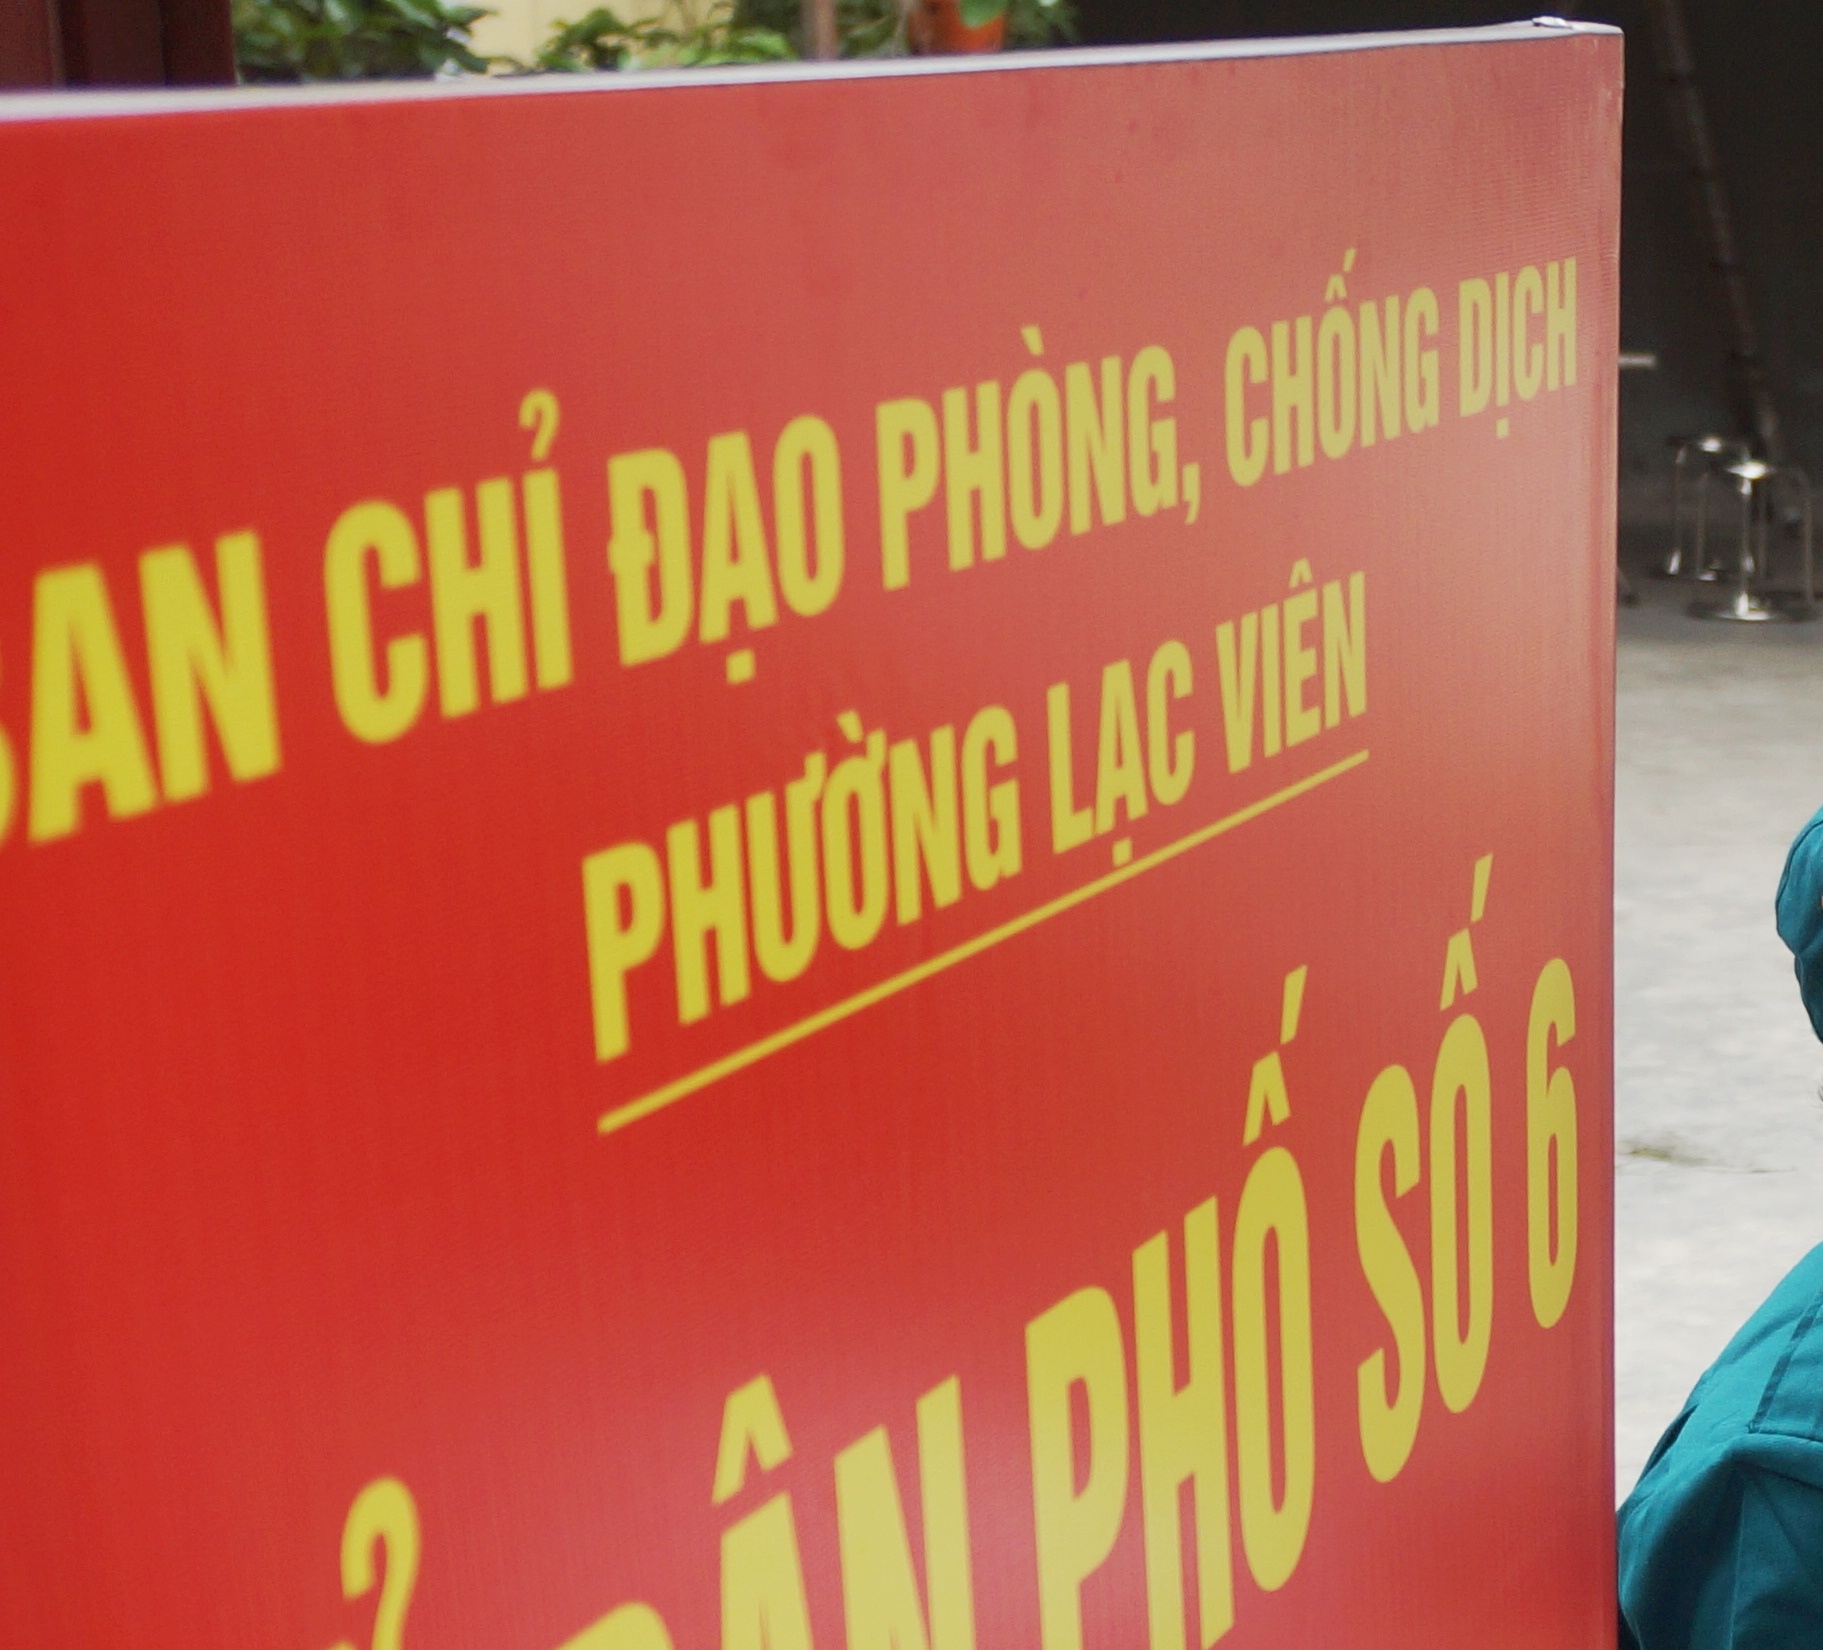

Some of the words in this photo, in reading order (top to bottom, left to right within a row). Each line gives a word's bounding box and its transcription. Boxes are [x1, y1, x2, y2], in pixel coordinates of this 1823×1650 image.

[0, 534, 280, 840] AN
[326, 390, 571, 742] CHỈ
[608, 415, 844, 685] ĐẠO
[876, 326, 1200, 590] PHÒNG,
[1224, 250, 1440, 487] CHỐNG
[1458, 257, 1577, 437] DỊCH
[583, 712, 1022, 1063] PHƯỜNG
[1048, 641, 1195, 868] LẠC
[1216, 560, 1367, 774] VIÊN
[1355, 856, 1494, 1484] SỐ
[1525, 957, 1578, 1329] 6
